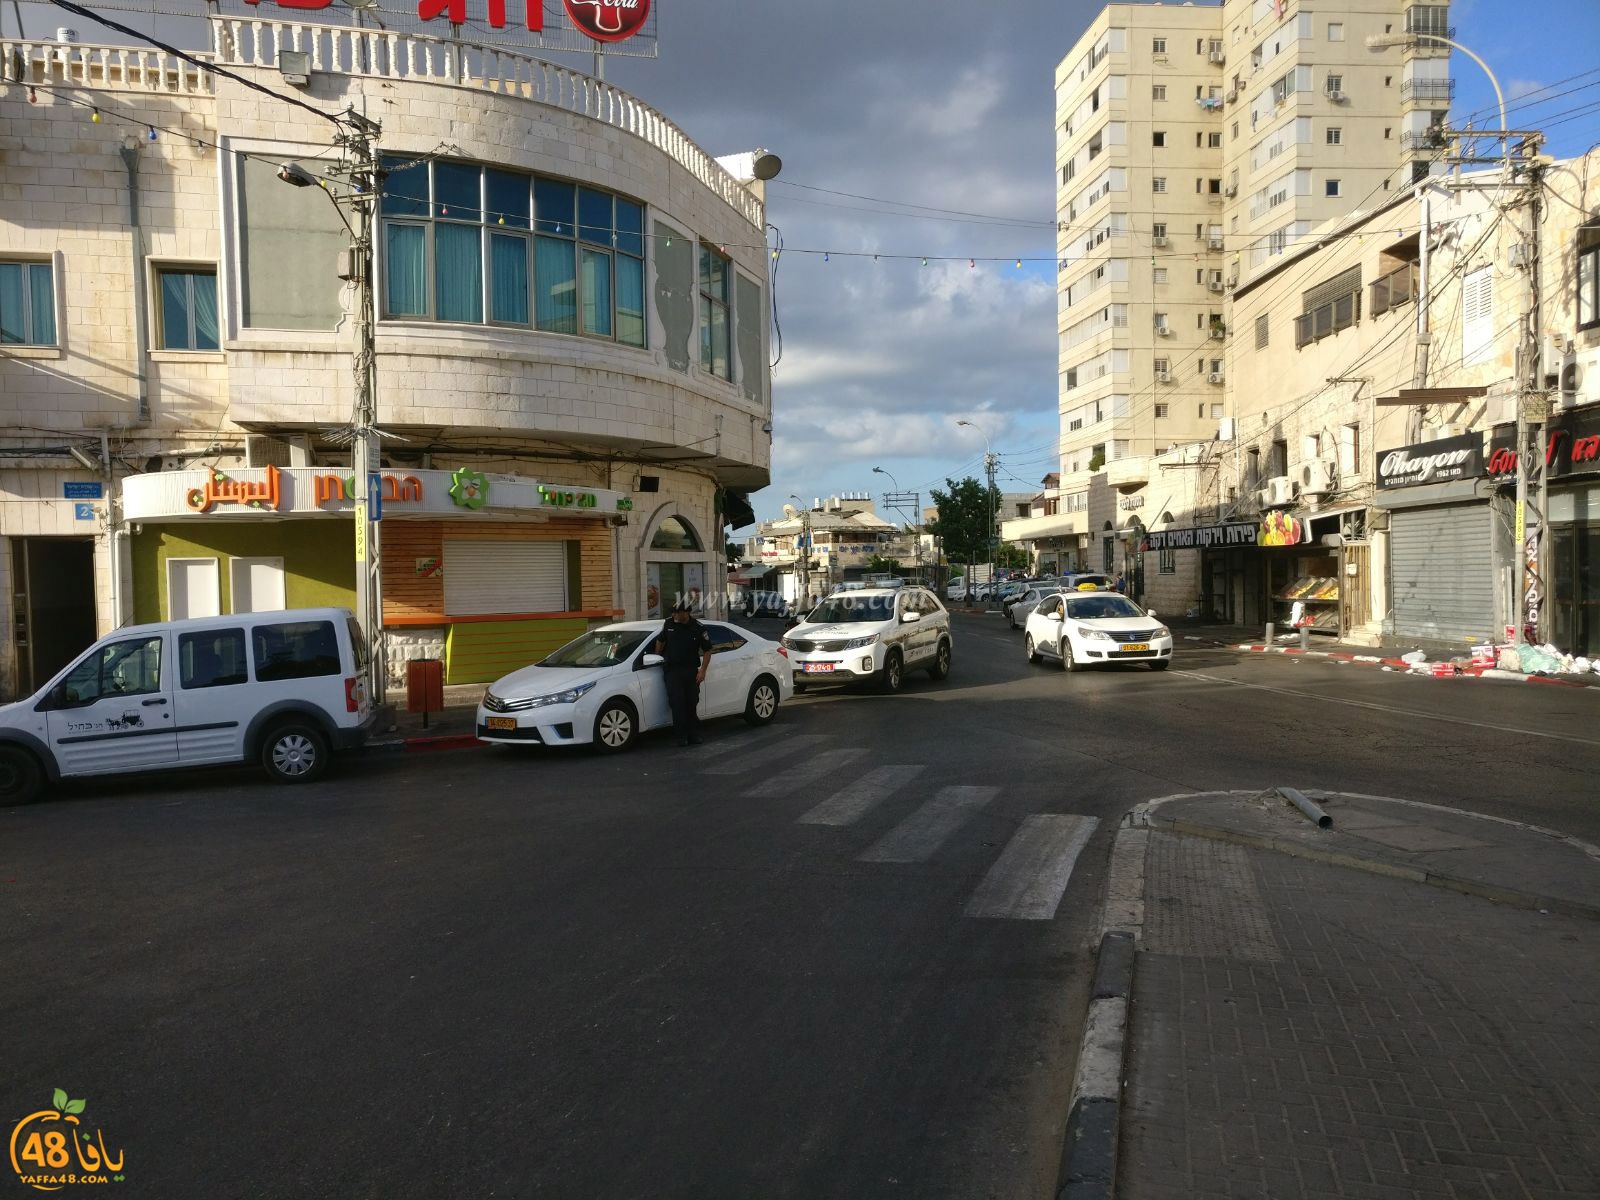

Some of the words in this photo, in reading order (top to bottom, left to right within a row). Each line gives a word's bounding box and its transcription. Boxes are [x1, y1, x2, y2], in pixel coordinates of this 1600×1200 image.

[1167, 529, 1194, 547] האחים
[1196, 527, 1223, 548] וירקות
[1226, 524, 1256, 543] פירות
